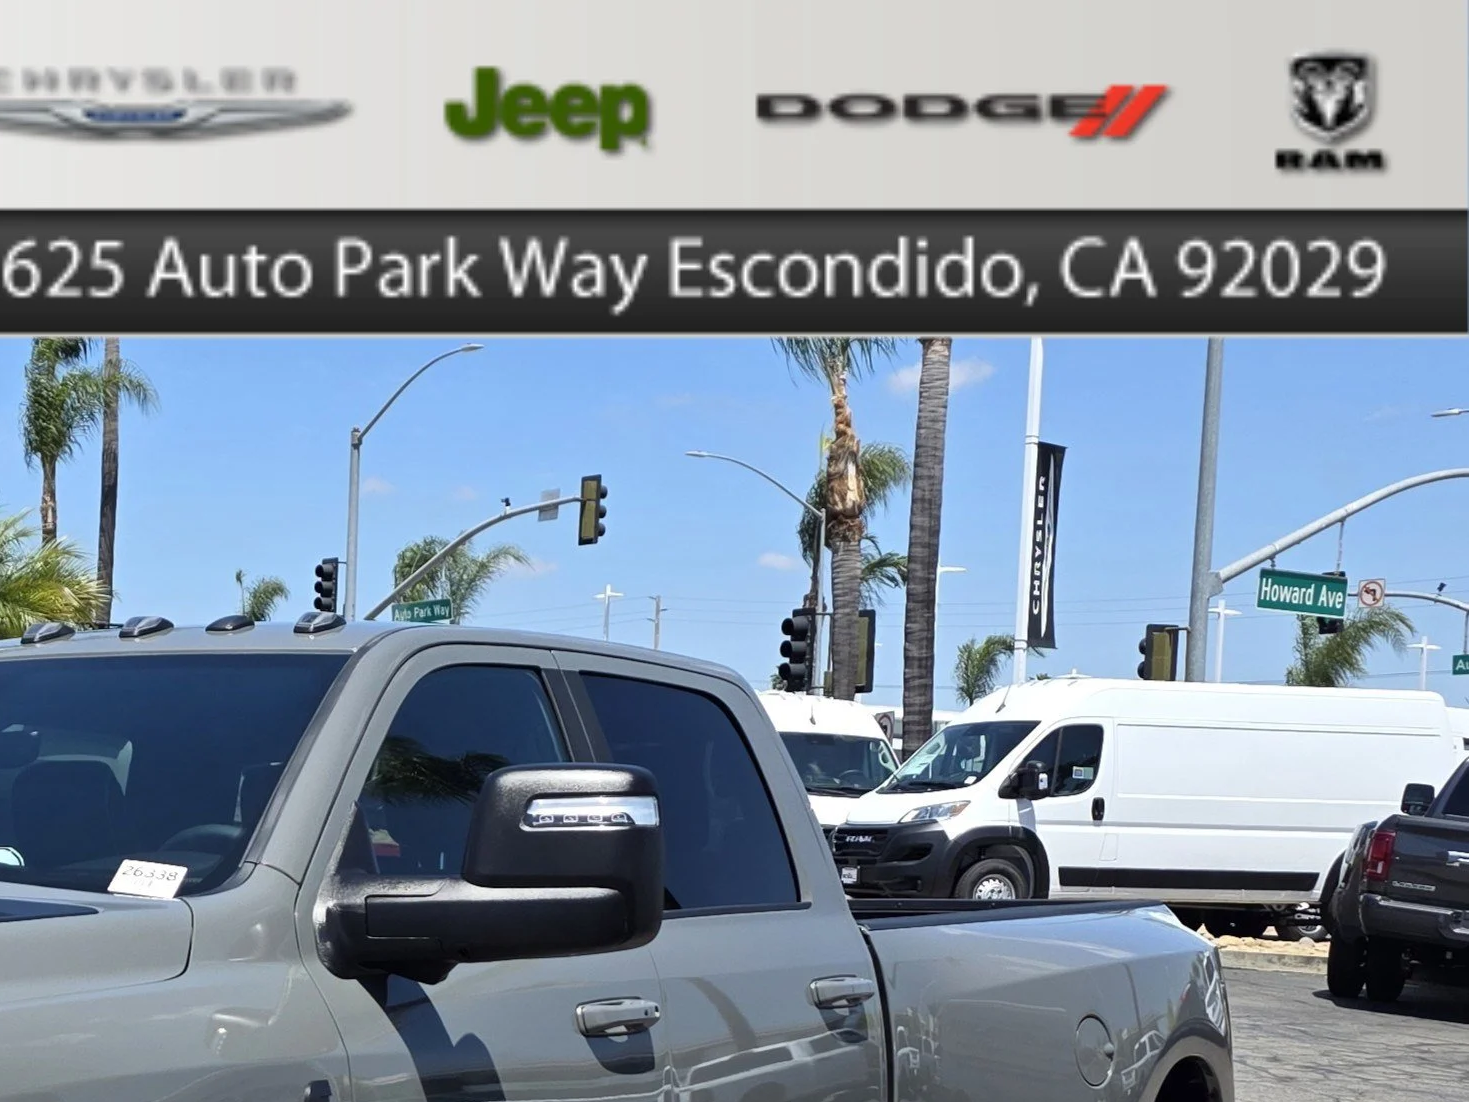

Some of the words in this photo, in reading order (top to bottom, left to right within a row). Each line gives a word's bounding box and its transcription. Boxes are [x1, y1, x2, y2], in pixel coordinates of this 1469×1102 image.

[1032, 475, 1046, 616] CHRYSLER
[1260, 577, 1315, 606] Howard
[1317, 584, 1344, 610] Ave
[413, 605, 432, 619] Park
[433, 604, 450, 617] Way
